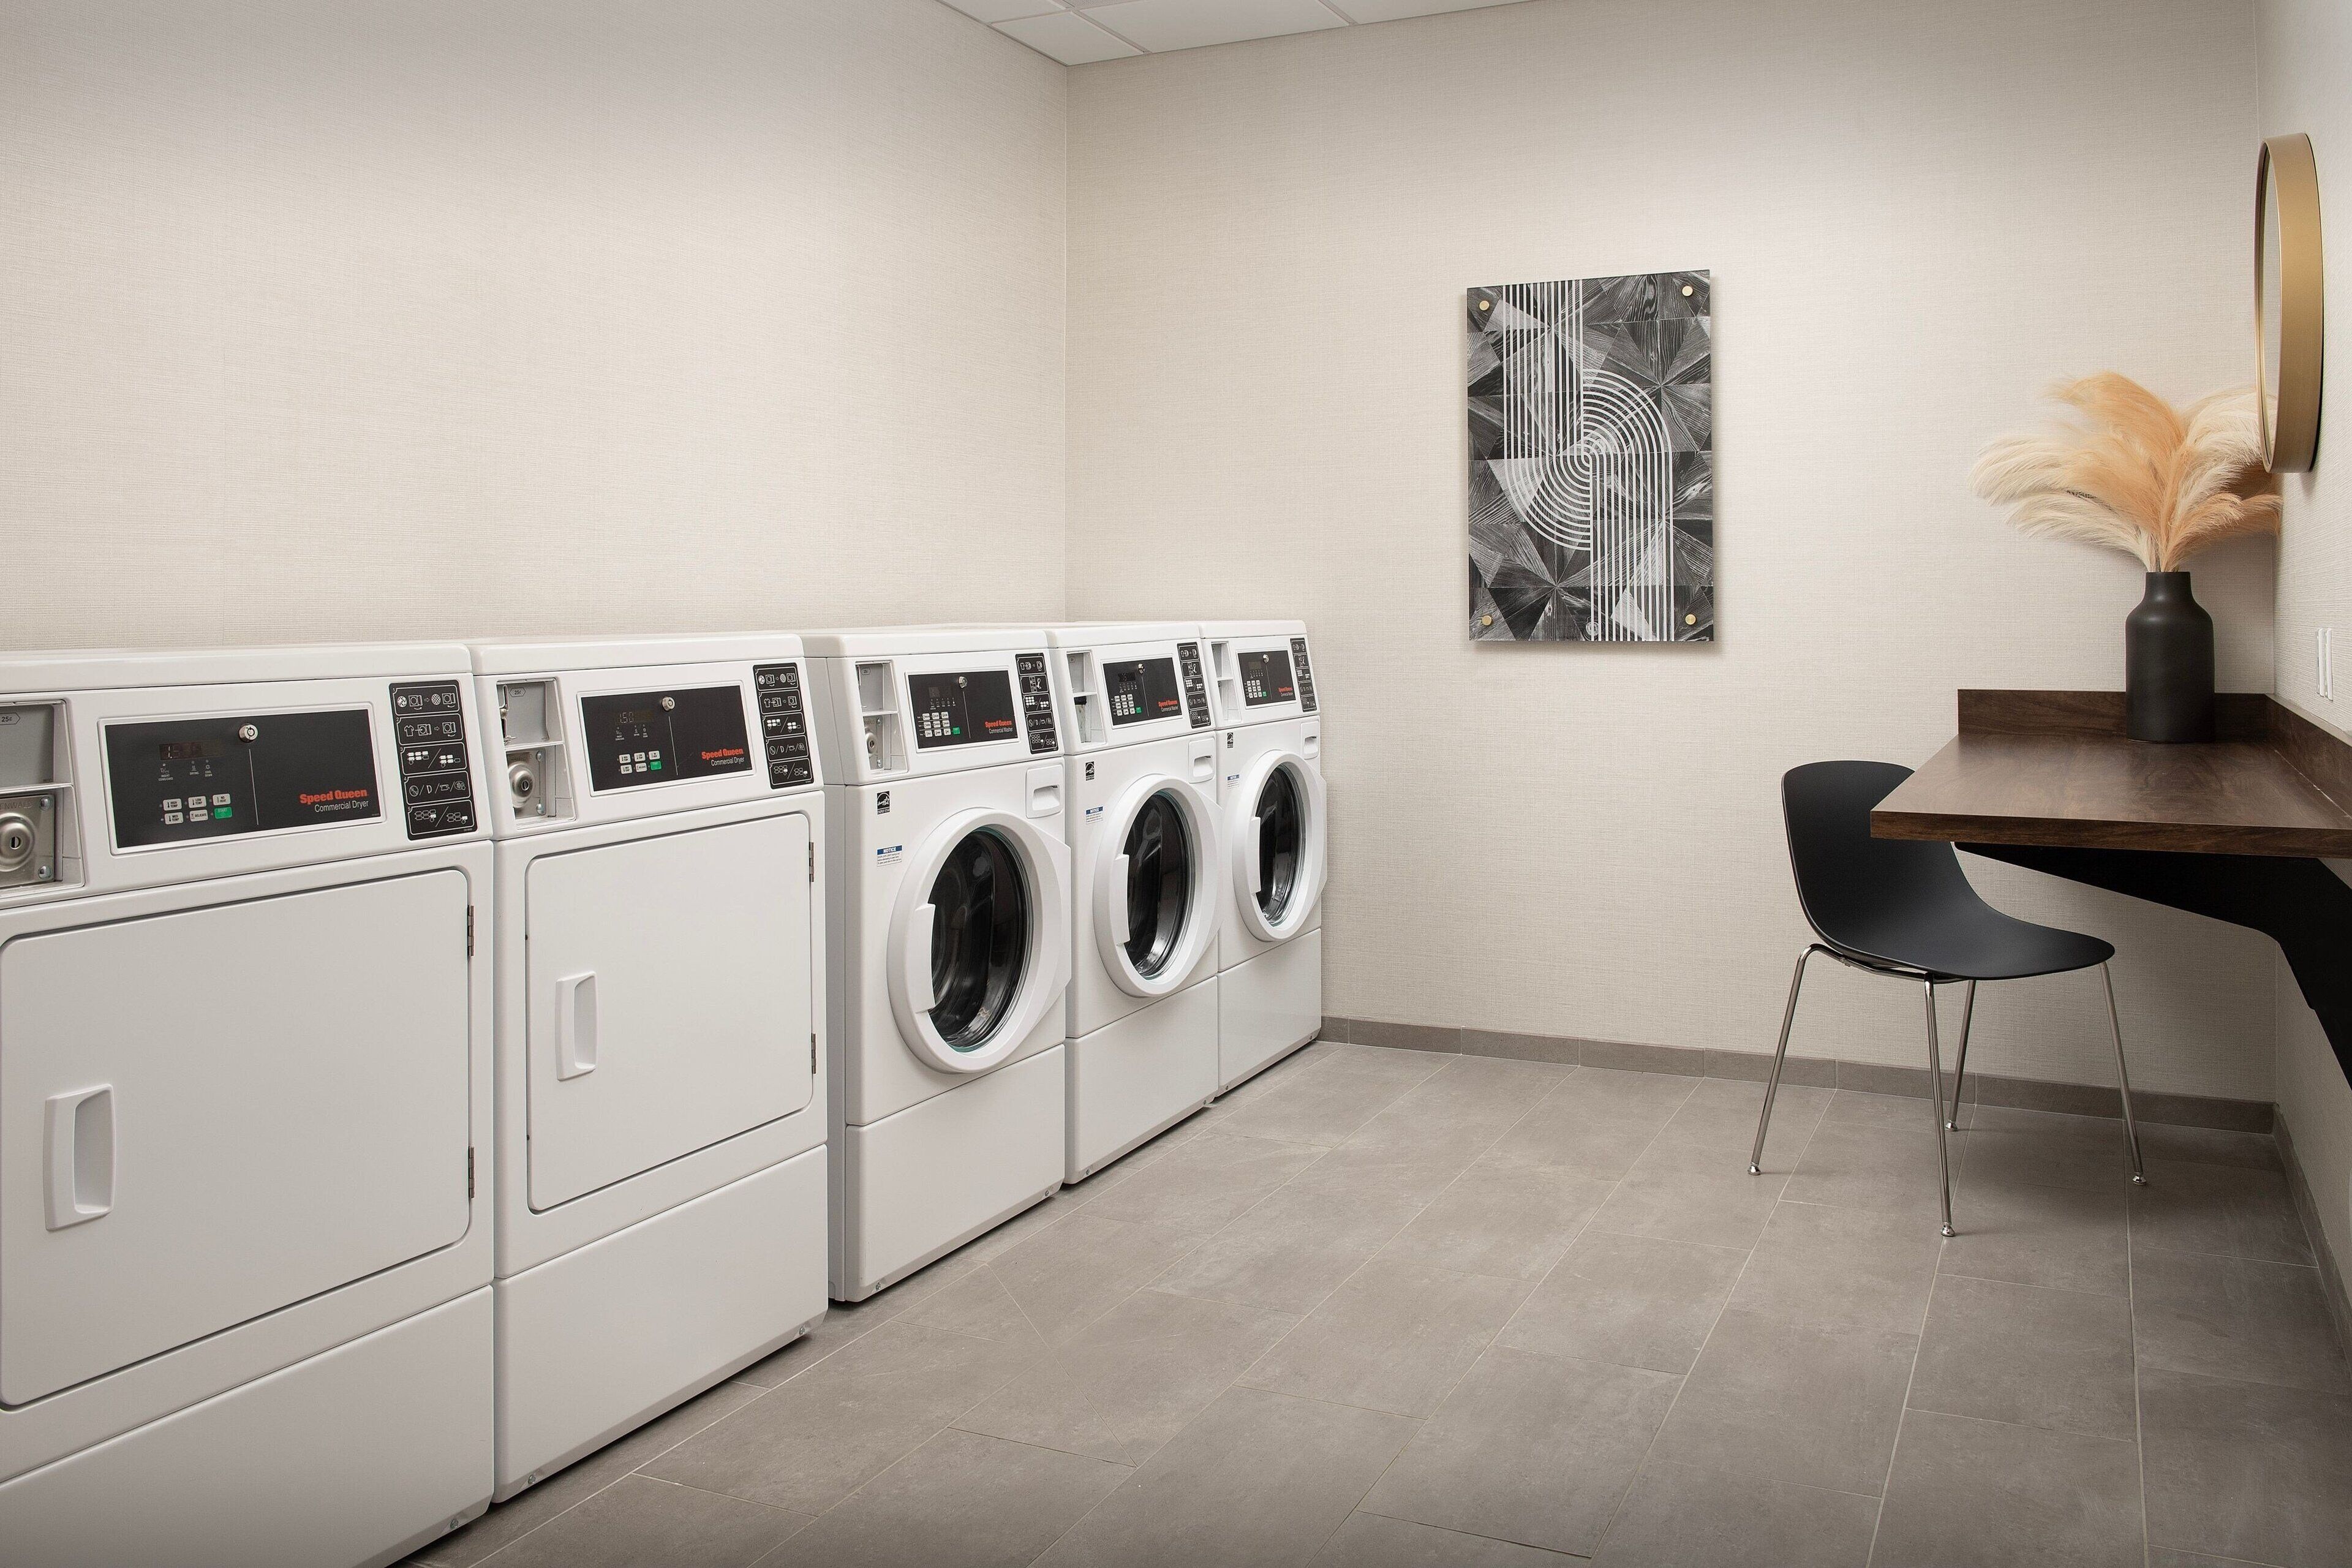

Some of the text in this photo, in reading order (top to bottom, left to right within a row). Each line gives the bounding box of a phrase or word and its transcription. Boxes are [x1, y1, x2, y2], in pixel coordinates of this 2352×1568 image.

[701, 749, 722, 760] Speed
[711, 758, 733, 766] Commercial
[300, 790, 368, 805] Speed Queen
[314, 800, 369, 813] Commercial Dryer
